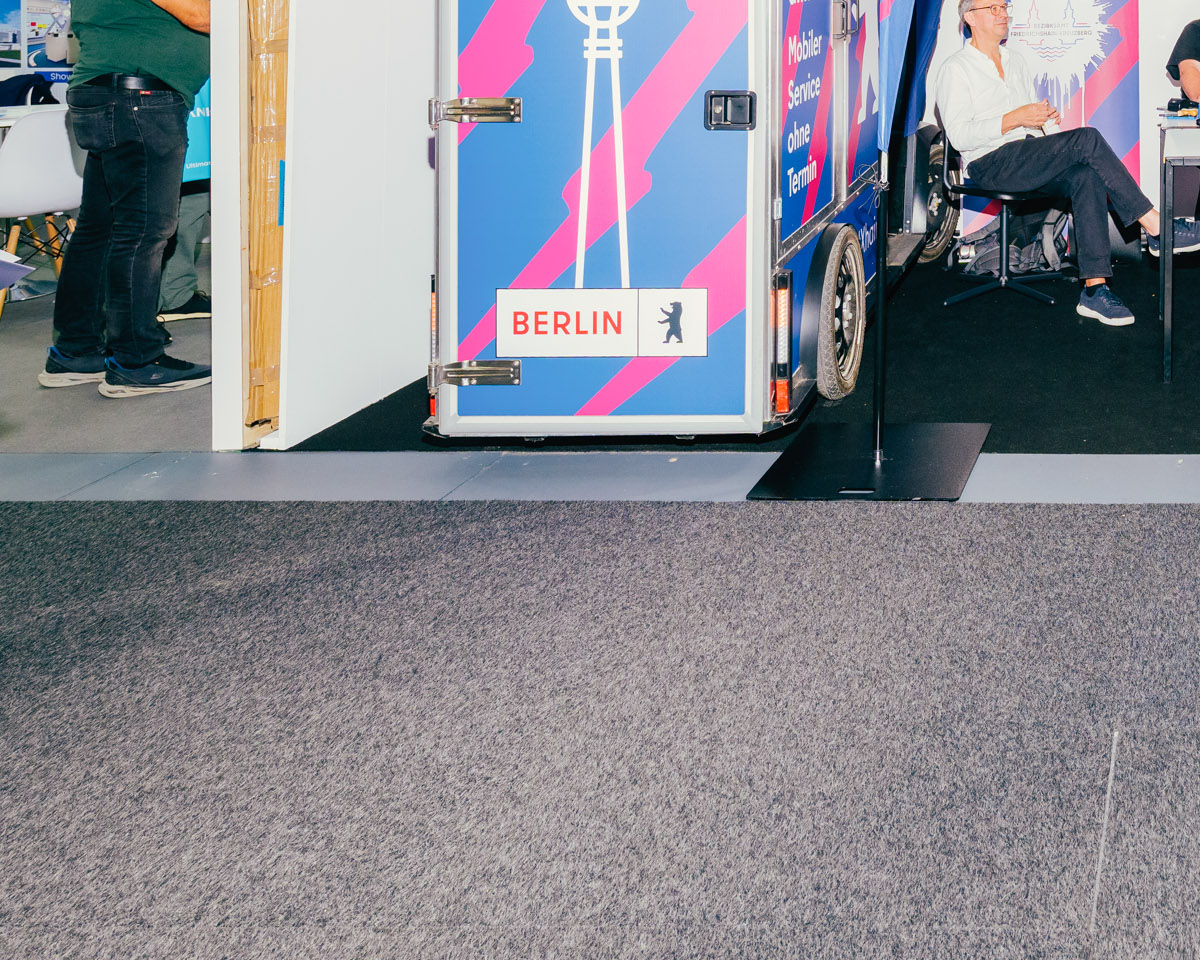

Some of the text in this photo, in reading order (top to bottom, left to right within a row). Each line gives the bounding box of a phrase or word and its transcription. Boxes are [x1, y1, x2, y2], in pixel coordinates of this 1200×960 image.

[788, 29, 822, 65] Mobiler
[788, 73, 821, 110] Service
[787, 121, 811, 154] ohne
[787, 155, 817, 197] Termin
[513, 311, 622, 335] BERLIN
